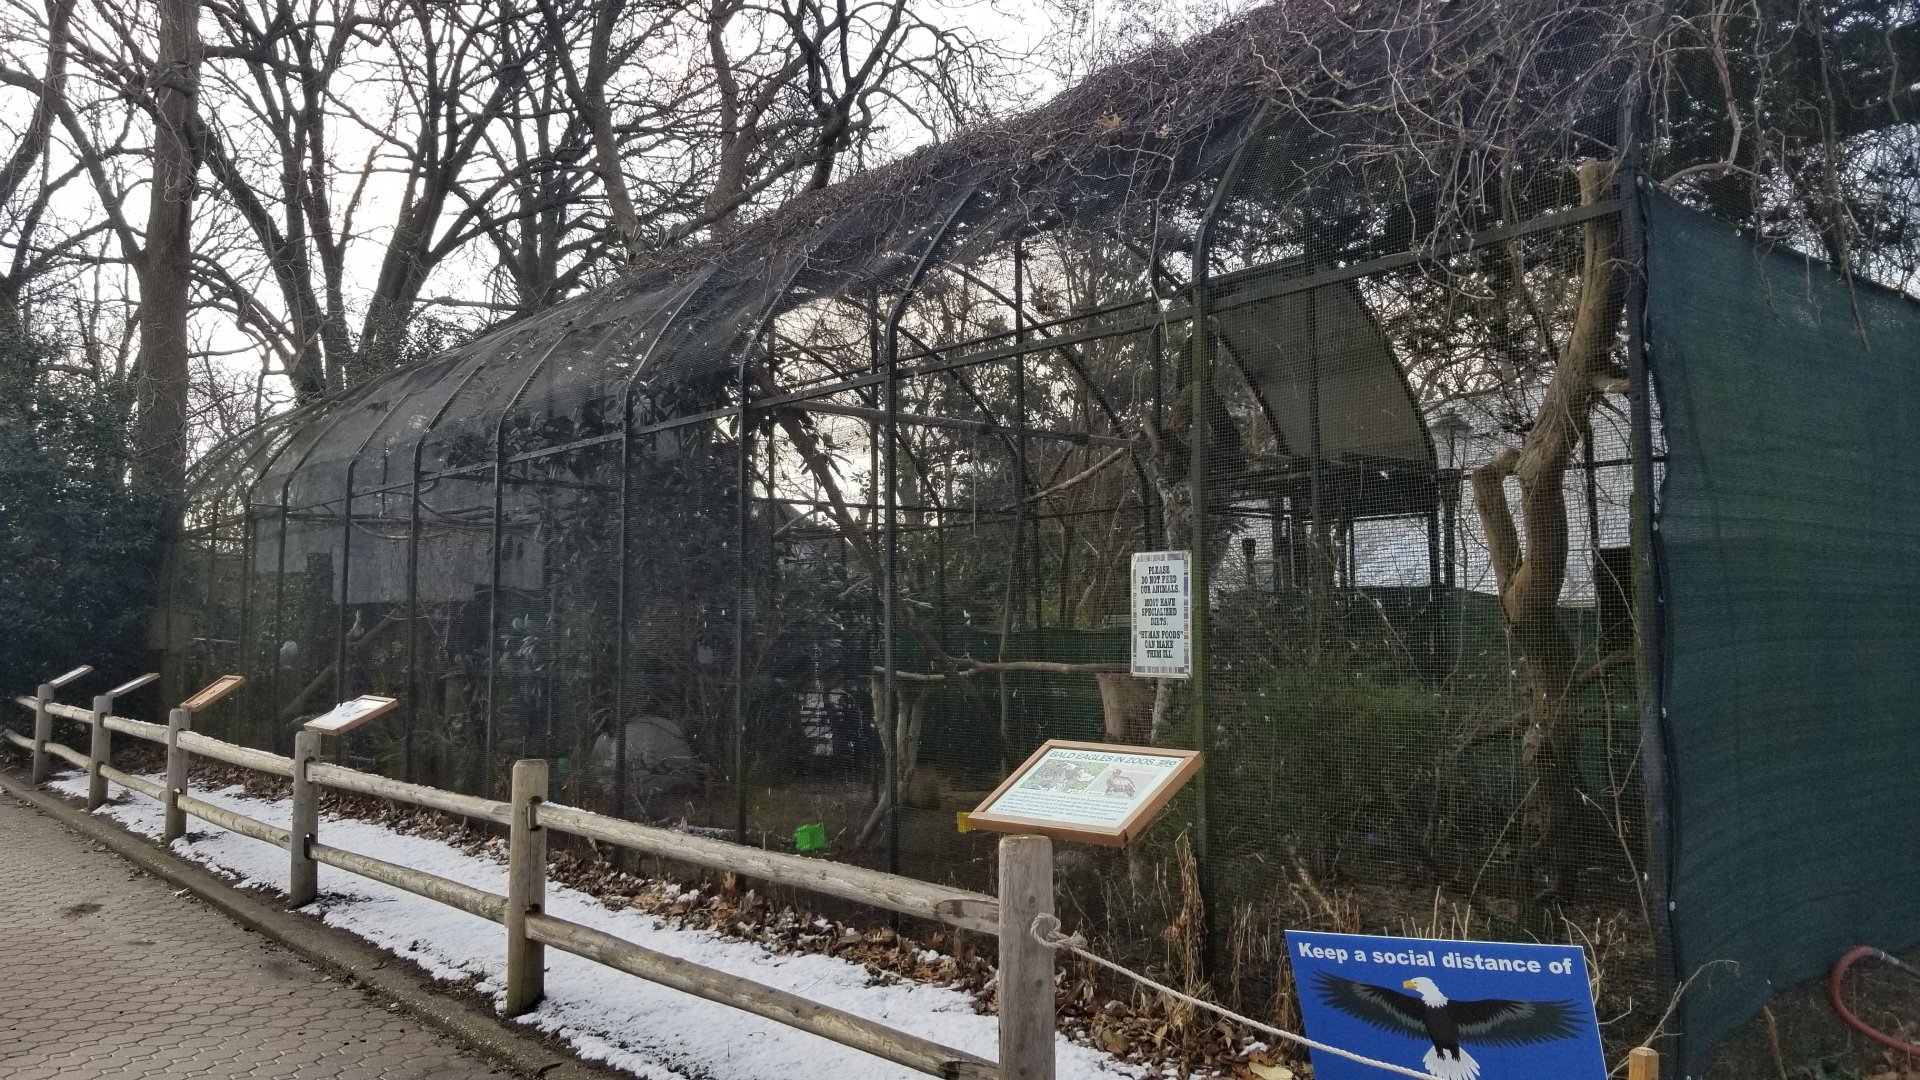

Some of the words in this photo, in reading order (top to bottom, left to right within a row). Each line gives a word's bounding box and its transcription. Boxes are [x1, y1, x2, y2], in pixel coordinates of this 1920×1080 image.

[1148, 566, 1170, 574] PLEASE
[1141, 576, 1148, 584] DO
[1149, 576, 1160, 584] NOT
[1162, 575, 1177, 584] FEED
[1141, 585, 1151, 594] OUR
[1152, 584, 1180, 593] ANIMALS.
[1144, 598, 1160, 606] MOST
[1160, 598, 1176, 606] HAVE
[1141, 608, 1177, 616] SPECIALIZED
[1150, 617, 1168, 625] DIETS.
[1144, 640, 1155, 648] CAN
[1156, 640, 1174, 648] MAKE
[1146, 650, 1161, 658] THEM
[1049, 751, 1076, 759] BALD
[1076, 752, 1114, 762] EAGLES
[1124, 756, 1155, 766] ZOOS
[1298, 942, 1348, 963] Keep
[1354, 950, 1367, 962] a
[1372, 949, 1436, 967] social
[1441, 952, 1542, 974] distance
[1548, 958, 1573, 975] of
